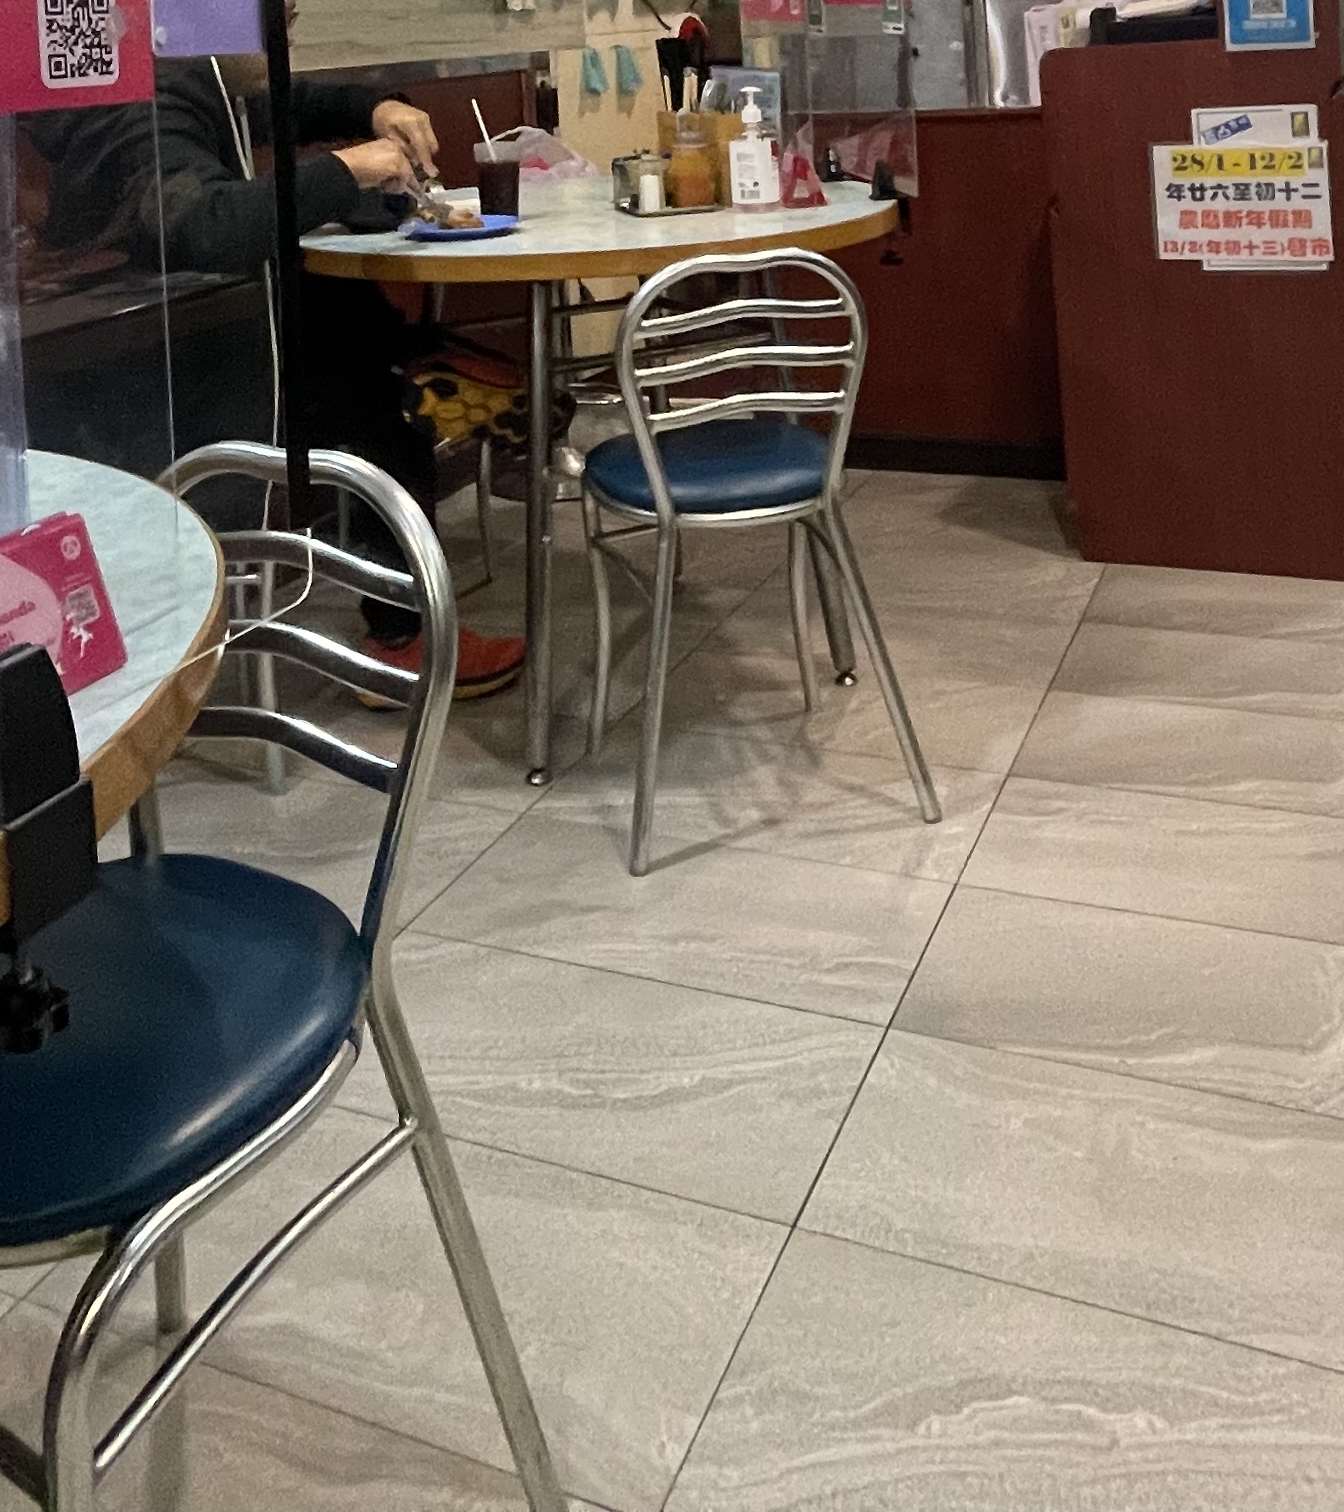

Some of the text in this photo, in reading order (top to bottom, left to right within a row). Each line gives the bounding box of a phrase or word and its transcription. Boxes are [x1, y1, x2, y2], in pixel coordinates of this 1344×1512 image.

[1172, 152, 1226, 172] 28/1
[1249, 151, 1304, 172] 12/2
[1165, 181, 1323, 202] 年廿六至初十二
